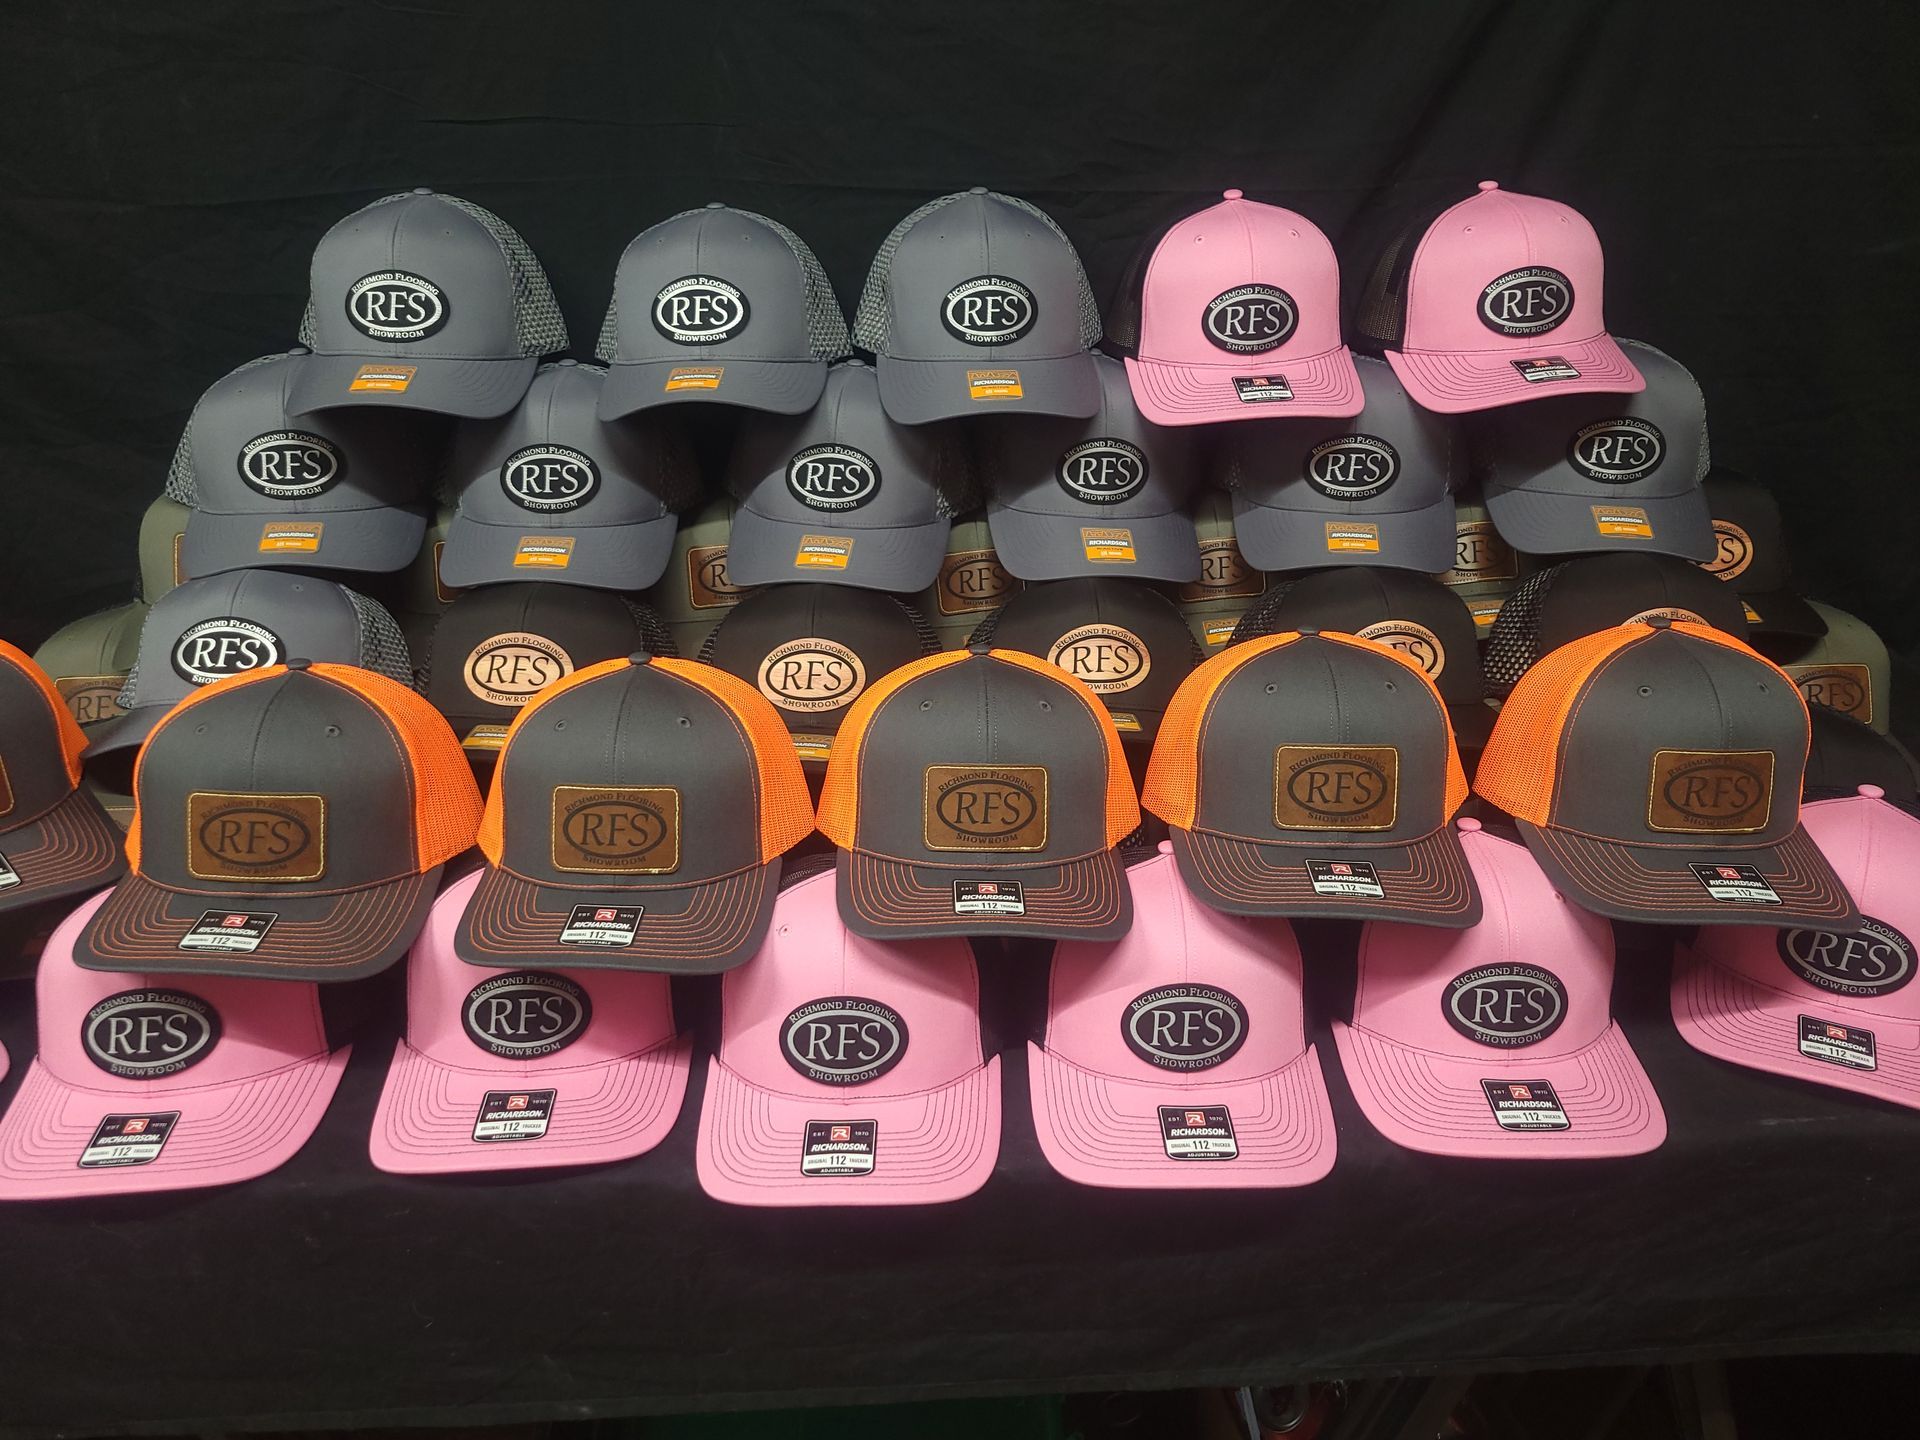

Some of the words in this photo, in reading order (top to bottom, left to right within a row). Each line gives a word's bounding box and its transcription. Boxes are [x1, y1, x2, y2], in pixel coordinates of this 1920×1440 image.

[352, 273, 393, 293] RICHMOND
[395, 273, 440, 296] FLOORING
[658, 279, 698, 300] RICHMOND
[699, 277, 741, 299] FLOORING
[948, 279, 989, 300] RICHMOND
[991, 278, 1029, 298] FLOORING
[1485, 270, 1530, 294] RICHMOND
[1532, 269, 1568, 285] FLOORING
[365, 291, 428, 322] RFS
[1210, 288, 1252, 309] RICHMOND
[1255, 286, 1291, 304] FLOORING
[1501, 284, 1558, 319] RFS
[671, 294, 728, 326] RFS
[962, 296, 1019, 327] RFS
[1223, 304, 1281, 336] RFS
[369, 328, 424, 338] SHOWROOM
[674, 332, 728, 342] SHOWROOM
[965, 332, 1017, 342] SHOWROOM
[1504, 321, 1557, 334] SHOWROOM
[1226, 340, 1278, 351] SHOWROOM
[1578, 420, 1623, 437] RICHMOND
[1625, 420, 1660, 440] FLOORING
[244, 433, 286, 454] RICHMOND
[288, 432, 333, 451] FLOORING
[1064, 441, 1105, 460] RICHMOND
[1107, 441, 1142, 460] FLOORING
[1312, 437, 1355, 456] RICHMOND
[1357, 437, 1393, 455] FLOORING
[1588, 436, 1649, 464] RFS
[260, 450, 321, 481] RFS
[507, 447, 547, 467] RICHMOND
[550, 446, 591, 466] FLOORING
[793, 447, 833, 466] RICHMOND
[835, 447, 874, 468] FLOORING
[1323, 453, 1382, 481] RFS
[520, 464, 578, 494] RFS
[804, 462, 861, 494] RFS
[1077, 457, 1132, 485] RFS
[1590, 470, 1642, 480] SHOWROOM
[264, 486, 322, 496] SHOWROOM
[1079, 491, 1129, 501] SHOWROOM
[1326, 487, 1377, 497] SHOWROOM
[524, 500, 578, 510] SHOWROOM
[806, 498, 857, 509] SHOWROOM
[181, 620, 228, 640] RICHMOND
[230, 620, 276, 643] FLOORING
[1056, 628, 1099, 649] RICHMOND
[1102, 628, 1141, 647] FLOORING
[1394, 624, 1433, 642] FLOORING
[191, 637, 261, 669] RFS
[476, 637, 520, 657] RICHMOND
[523, 637, 564, 659] FLOORING
[769, 642, 812, 663] RICHMOND
[814, 642, 855, 664] FLOORING
[485, 654, 549, 686] RFS
[1072, 645, 1128, 674] RFS
[781, 661, 842, 690] RFS
[783, 698, 839, 708] SHOWROOM
[1807, 683, 1855, 708] RFS
[1290, 752, 1340, 772] RICHMOND
[1343, 752, 1385, 771] FLOORING
[938, 772, 988, 792] RICHMOND
[990, 770, 1033, 792] FLOORING
[1305, 771, 1371, 804] RFS
[1683, 775, 1748, 808] RFS
[565, 794, 613, 813] RICHMOND
[616, 793, 663, 813] FLOORING
[953, 791, 1021, 825] RFS
[1307, 812, 1368, 823] SHOWROOM
[217, 819, 292, 854] RFS
[580, 813, 649, 847] RFS
[956, 833, 1017, 844] SHOWROOM
[582, 855, 646, 865] SHOWROOM
[1736, 889, 1753, 897] 112
[198, 927, 256, 936] RICHARDSON
[589, 931, 606, 939] 112
[1861, 919, 1910, 951] FLOORING
[1804, 931, 1891, 977] RFS
[472, 977, 523, 999] RICHMOND
[527, 976, 578, 995] FLOORING
[1453, 967, 1510, 989] RICHMOND
[1513, 967, 1559, 988] FLOORING
[1804, 970, 1877, 994] SHOWROOM
[90, 994, 145, 1019] RICHMOND
[148, 993, 205, 1012] FLOORING
[1131, 989, 1187, 1011] RICHMOND
[1190, 988, 1238, 1010] FLOORING
[1471, 988, 1545, 1023] RFS
[487, 997, 563, 1034] RFS
[790, 1001, 843, 1023] RICHMOND
[846, 1001, 897, 1023] FLOORING
[107, 1013, 188, 1054] RFS
[1150, 1009, 1223, 1047] RFS
[1475, 1032, 1542, 1044] SHOWROOM
[491, 1042, 561, 1055] SHOWROOM
[806, 1022, 881, 1061] RFS
[1808, 1034, 1866, 1052] RICHARDSON
[1829, 1048, 1846, 1057] 112
[111, 1061, 186, 1075] SHOWROOM
[1154, 1055, 1221, 1068] SHOWROOM
[810, 1069, 878, 1082] SHOWROOM
[486, 1111, 543, 1119] RICHARDSON
[1523, 1112, 1541, 1121] 112
[503, 1123, 520, 1132] 112
[1171, 1128, 1225, 1136] RICHARDSON
[98, 1135, 159, 1144] RICHARDSON
[1193, 1140, 1210, 1149] 112
[112, 1147, 131, 1156] 112
[830, 1156, 846, 1164] 112
